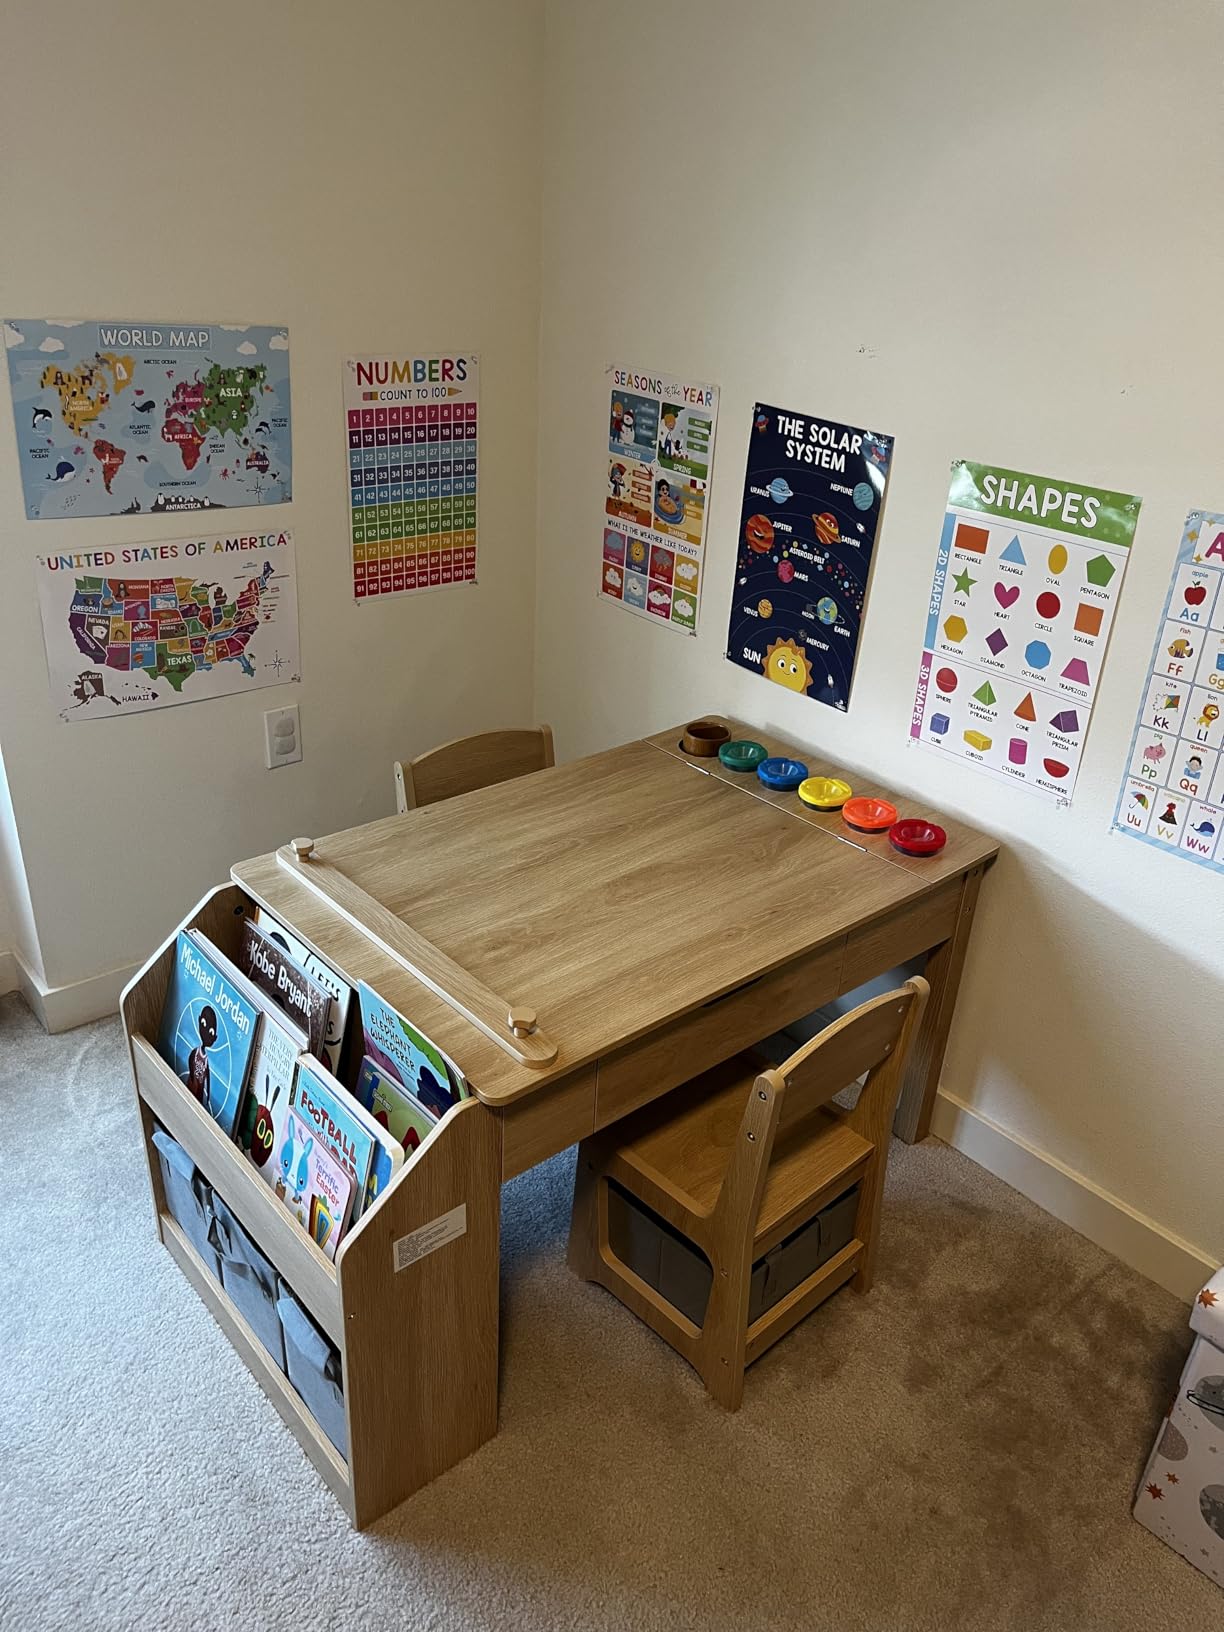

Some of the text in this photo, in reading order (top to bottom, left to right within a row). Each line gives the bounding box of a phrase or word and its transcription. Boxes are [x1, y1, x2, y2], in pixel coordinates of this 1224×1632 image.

[102, 328, 209, 348] WORLD MAP
[356, 359, 467, 386] NUMBERS
[220, 388, 242, 397] ASIA
[380, 387, 446, 400] COUNT TO 100
[615, 371, 662, 394] SEASONS
[683, 386, 712, 407] YEAR
[777, 415, 862, 455] THE SOLAR
[624, 450, 641, 459] WINTER
[786, 440, 845, 473] SYSTEM
[674, 464, 692, 474] SPRING
[750, 486, 770, 498] URANUS
[830, 483, 853, 496] NEPTUNE
[165, 502, 201, 510] ANTARCTICA
[980, 474, 1101, 528] SHAPES
[772, 521, 793, 533] JUPITER
[608, 519, 620, 529] WHAT
[629, 527, 638, 535] THE
[640, 530, 663, 543] WEATHER
[664, 540, 676, 549] LIKE
[841, 536, 860, 548] SATURN
[48, 533, 287, 571] UNITED STATES OF AMERICA
[789, 546, 825, 565] ASTEROID BELT
[954, 553, 982, 565] RECTANGLE
[794, 571, 809, 582] MARS
[999, 564, 1024, 576] TRIANGLE
[1192, 570, 1209, 579] apple
[929, 550, 948, 616] 2D SHAPES
[1045, 578, 1060, 587] OVAL
[1080, 586, 1110, 600] PENTAGON
[72, 604, 98, 613] OREGON
[954, 599, 967, 607] STAR
[743, 606, 758, 617] VENUS
[994, 612, 1010, 620] HEART
[1179, 608, 1200, 622] Aa
[88, 617, 109, 625] NEVADA
[834, 626, 850, 637] EARTH
[1034, 623, 1053, 633] CIRCLE
[76, 626, 96, 650] CALIFORNIA
[806, 637, 830, 651] MERCURY
[1073, 635, 1094, 647] SQUARE
[743, 648, 761, 664] SUN
[940, 644, 964, 656] HEXAGON
[167, 655, 192, 666] TEXAS
[980, 657, 1005, 669] DIAMOND
[1021, 670, 1046, 682] OCTAGON
[1167, 662, 1184, 677] Ff
[912, 664, 930, 726] 3D SHAPES
[1058, 682, 1088, 698] TRAPEZOID
[936, 694, 952, 704] SPHERE
[968, 702, 998, 717] TRIANGULAR
[969, 710, 993, 723] PYRAMID
[1153, 715, 1170, 729] Kk
[1016, 723, 1030, 733] CONE
[1046, 731, 1079, 747] TRIANGULAR
[1154, 732, 1163, 740] pig
[1196, 729, 1209, 742] Ll
[1052, 741, 1069, 752] PRISM
[1190, 744, 1208, 754] queen
[965, 751, 984, 761] CUBOID
[1001, 766, 1026, 778] CYLINDER
[1141, 764, 1157, 779] Pp
[1035, 778, 1068, 795] HEMISPHERE
[1130, 779, 1155, 792] umbrella
[1179, 778, 1199, 795] Qq
[1199, 805, 1217, 814] whale
[1127, 812, 1141, 827] Uu
[1157, 824, 1174, 839] Vv
[1186, 836, 1210, 854] Ww
[249, 940, 275, 980] Kobe
[277, 964, 312, 1018] Bryant
[180, 943, 250, 1034] Michael Jordan
[380, 1007, 395, 1028] THE
[371, 1013, 411, 1056] ELEPHANT
[370, 1029, 417, 1073] WHISPERER
[301, 1089, 357, 1166] FOOTBALL
[316, 1158, 339, 1195] Terrific
[315, 1175, 340, 1207] Easter
